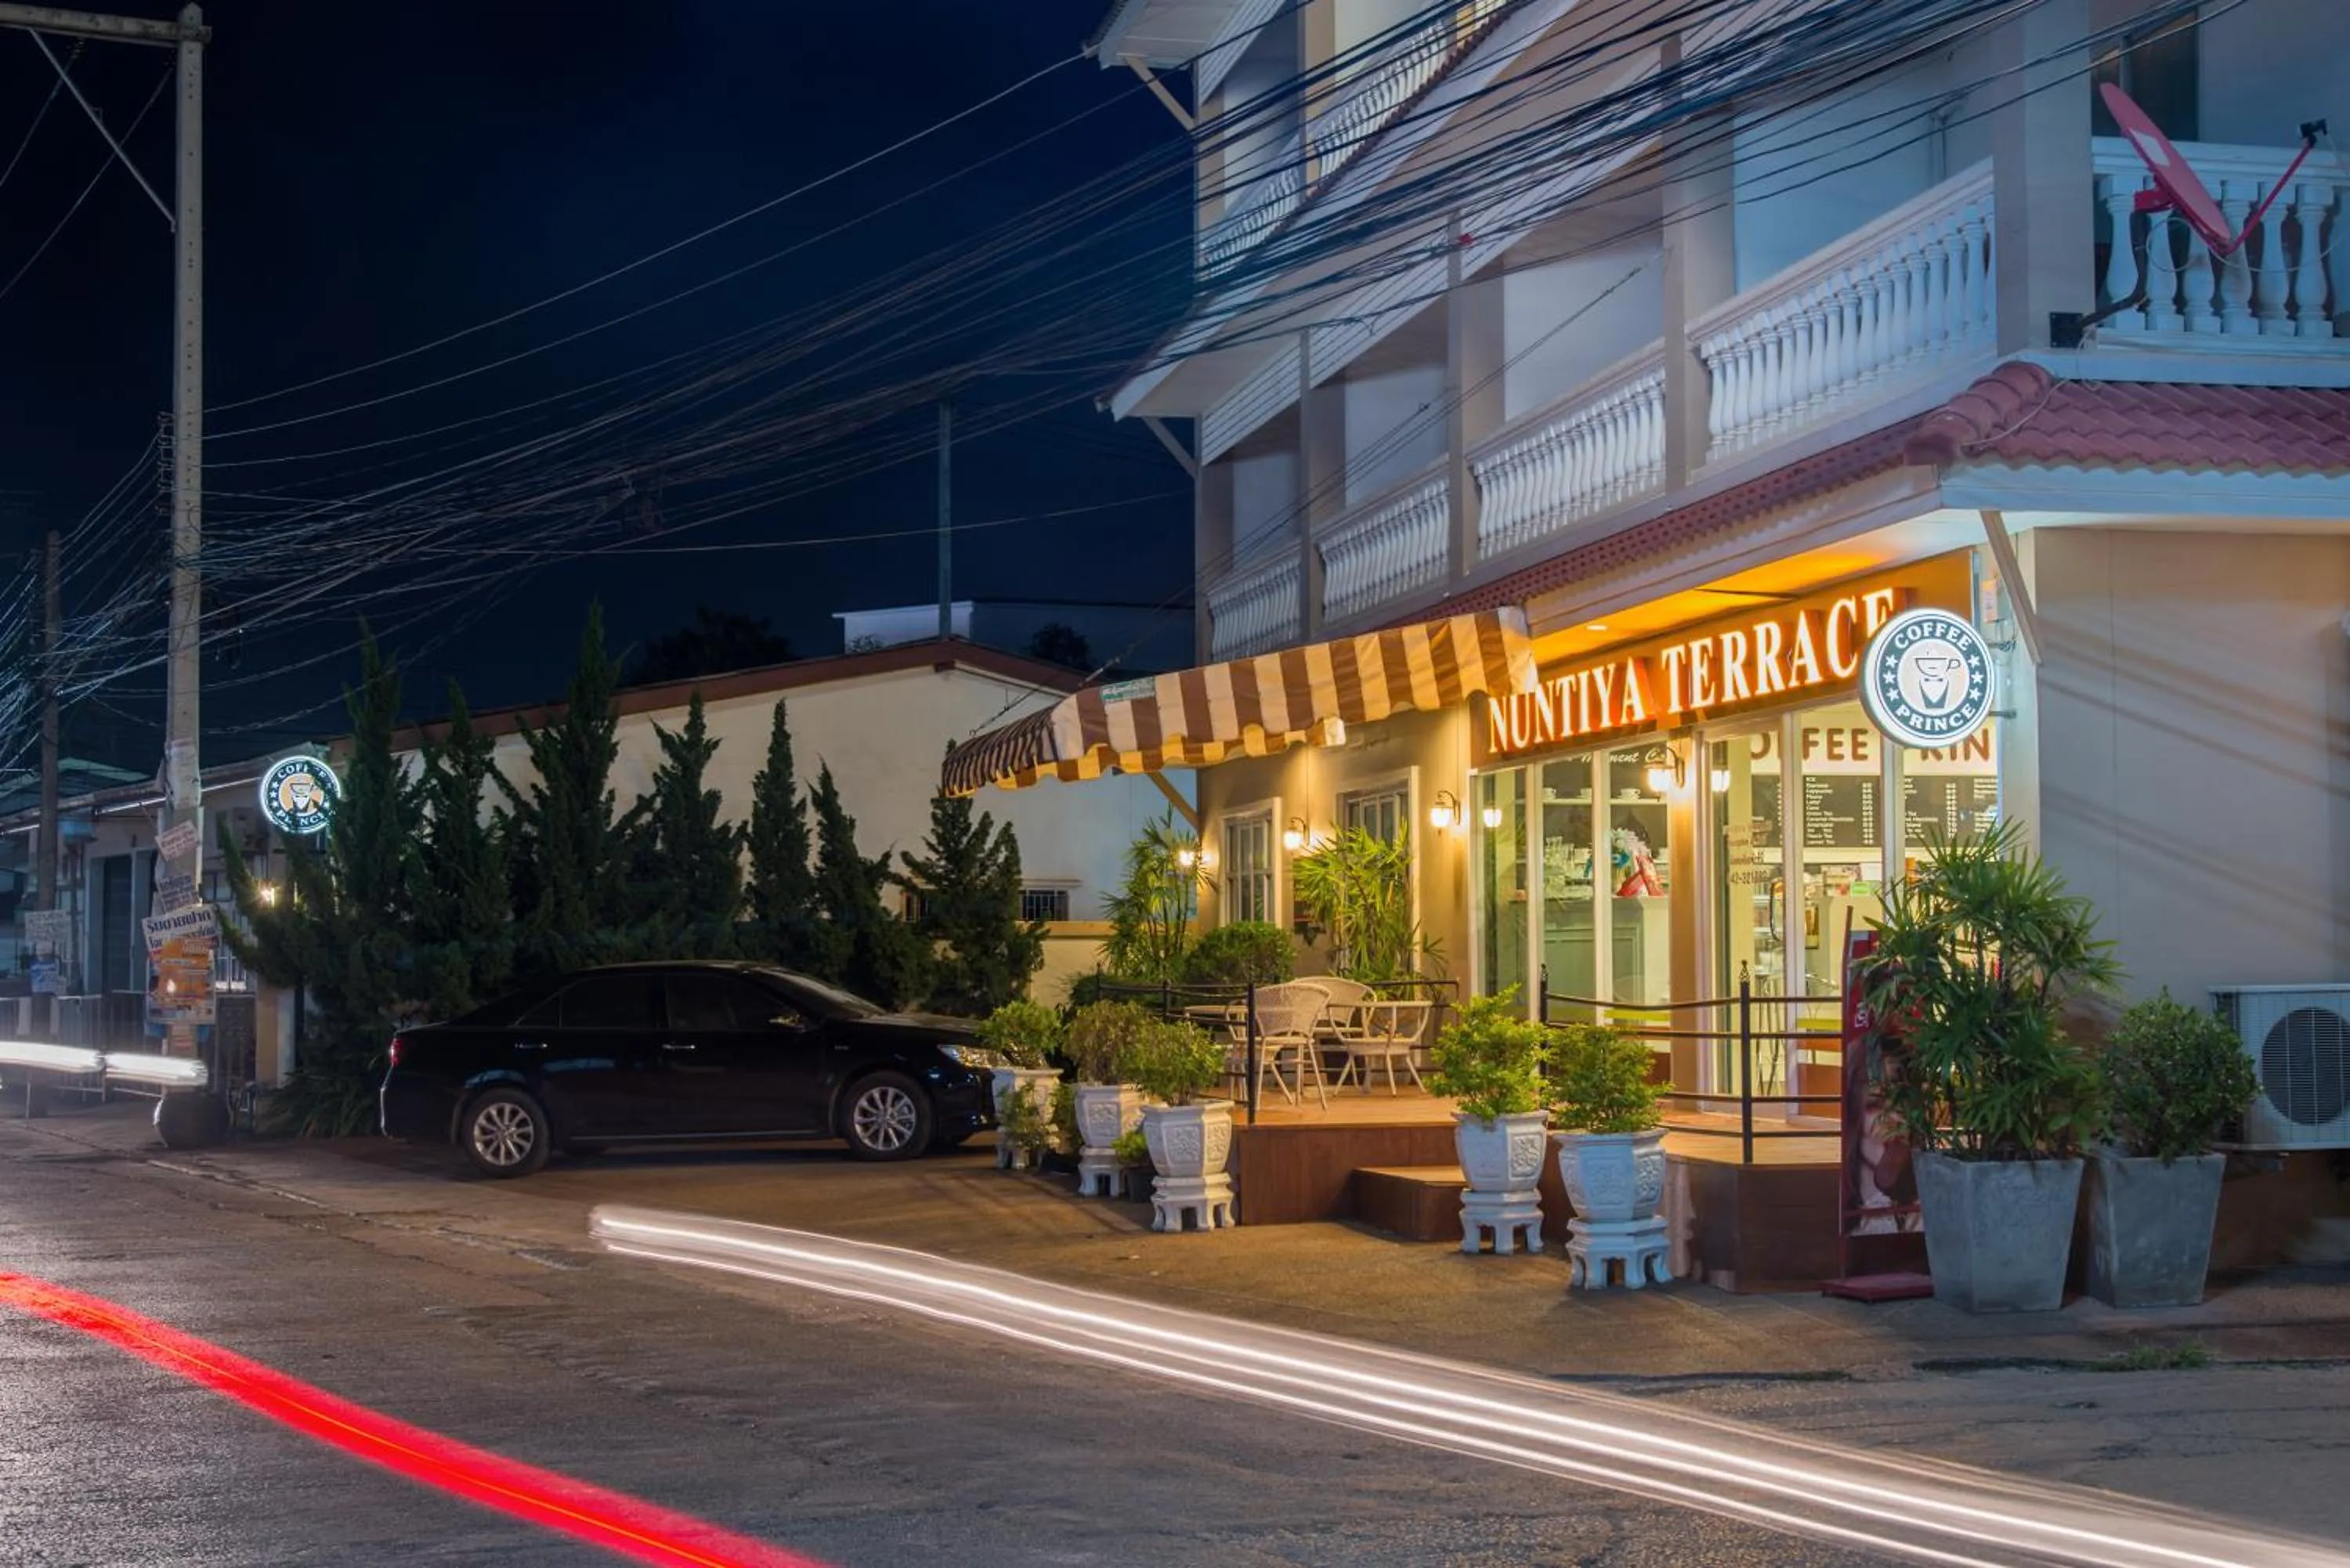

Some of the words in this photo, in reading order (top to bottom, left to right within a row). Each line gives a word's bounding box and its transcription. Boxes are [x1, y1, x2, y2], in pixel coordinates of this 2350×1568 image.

[1894, 622, 1972, 651] COFFEE
[1489, 656, 1646, 753] NUNTIYA
[1896, 703, 1976, 732] PRINCE
[277, 764, 327, 779] COFE
